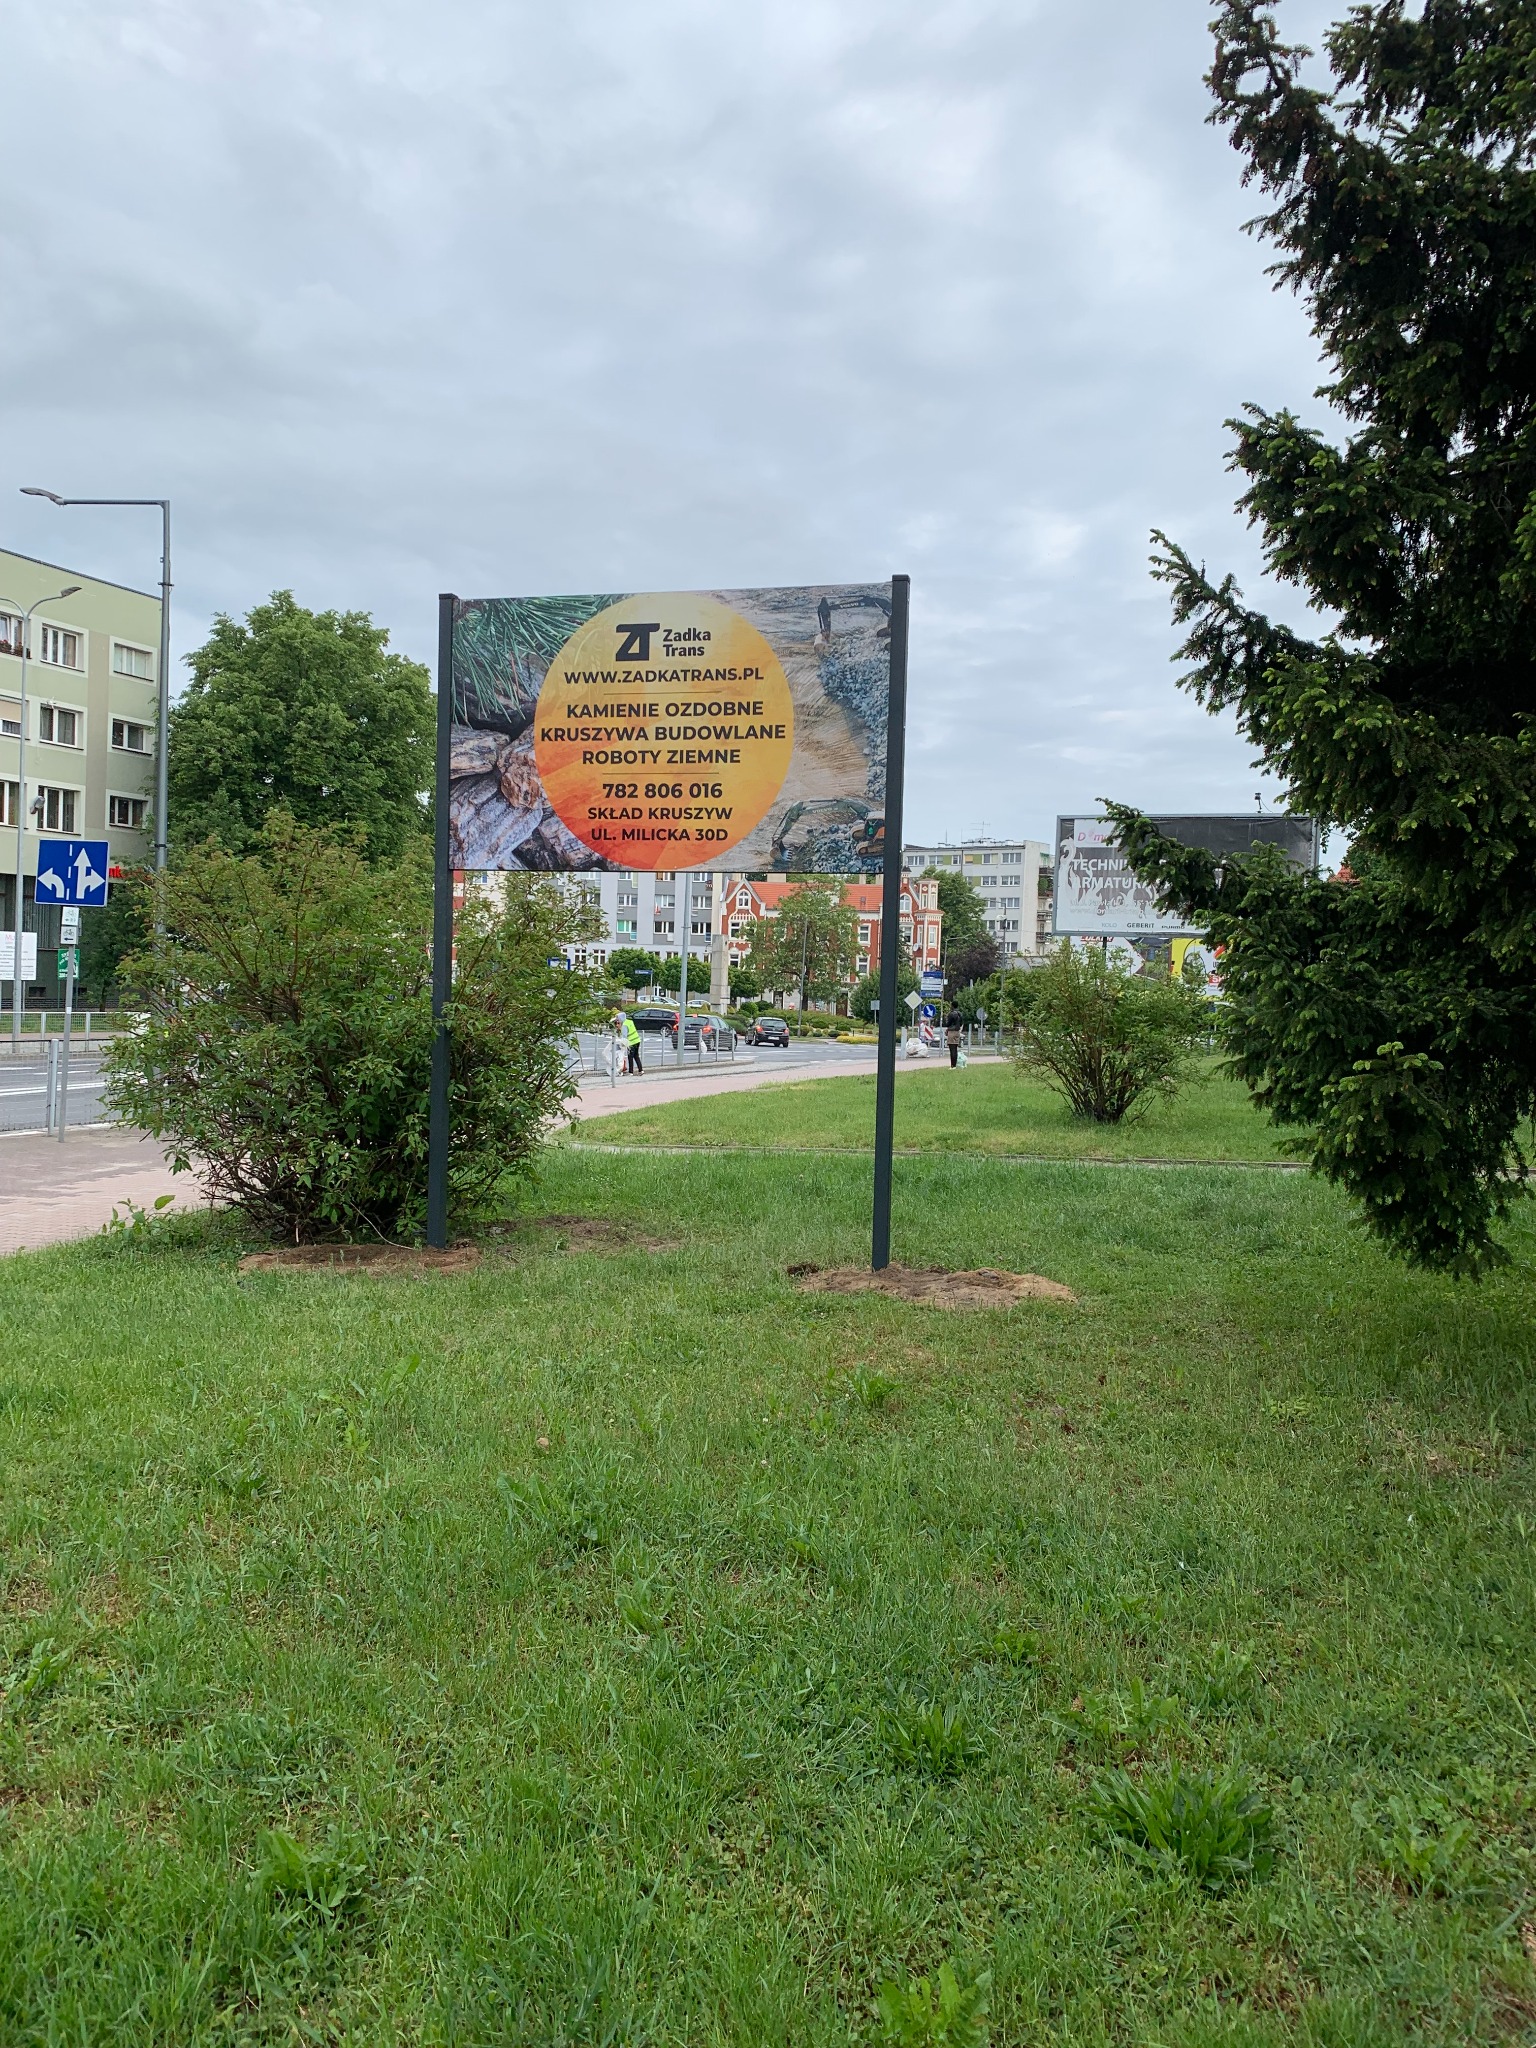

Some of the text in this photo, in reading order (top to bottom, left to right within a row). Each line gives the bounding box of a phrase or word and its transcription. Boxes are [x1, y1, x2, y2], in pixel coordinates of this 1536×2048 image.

[662, 628, 711, 642] Zadka
[663, 644, 705, 657] Trans
[564, 667, 764, 684] WWW.ZADKATRANS.PL
[567, 701, 764, 718] KAMIENIE OZDOBNE
[541, 724, 786, 742] KRUSZYWA BUDOWLANE
[582, 749, 741, 765] ROBOTY ZIEMNE
[602, 782, 723, 799] 782 806 016
[588, 807, 733, 820] SKŁAD KRUSZYW
[591, 828, 728, 841] UL. MILICKA 30D
